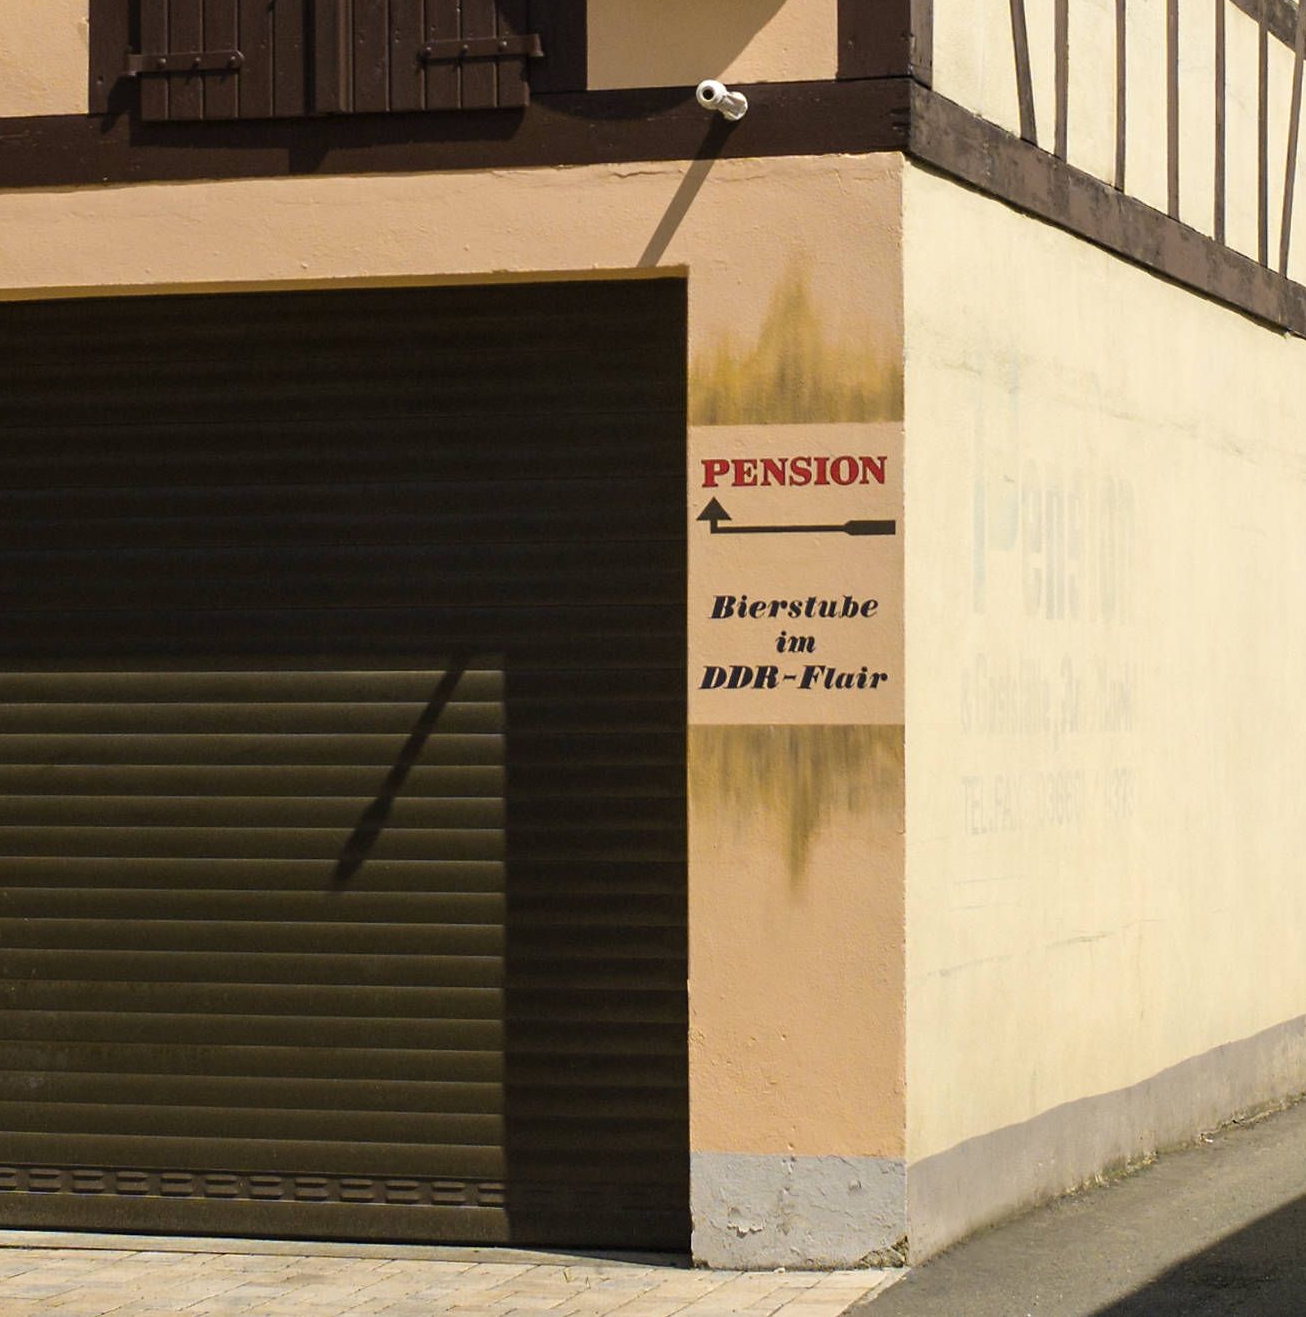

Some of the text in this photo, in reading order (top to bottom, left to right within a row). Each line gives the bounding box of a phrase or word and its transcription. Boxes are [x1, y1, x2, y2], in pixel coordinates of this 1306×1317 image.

[701, 456, 888, 488] PENSION
[708, 594, 879, 620] Bierstube
[775, 630, 817, 654] im
[698, 665, 889, 690] DDR-Flair
